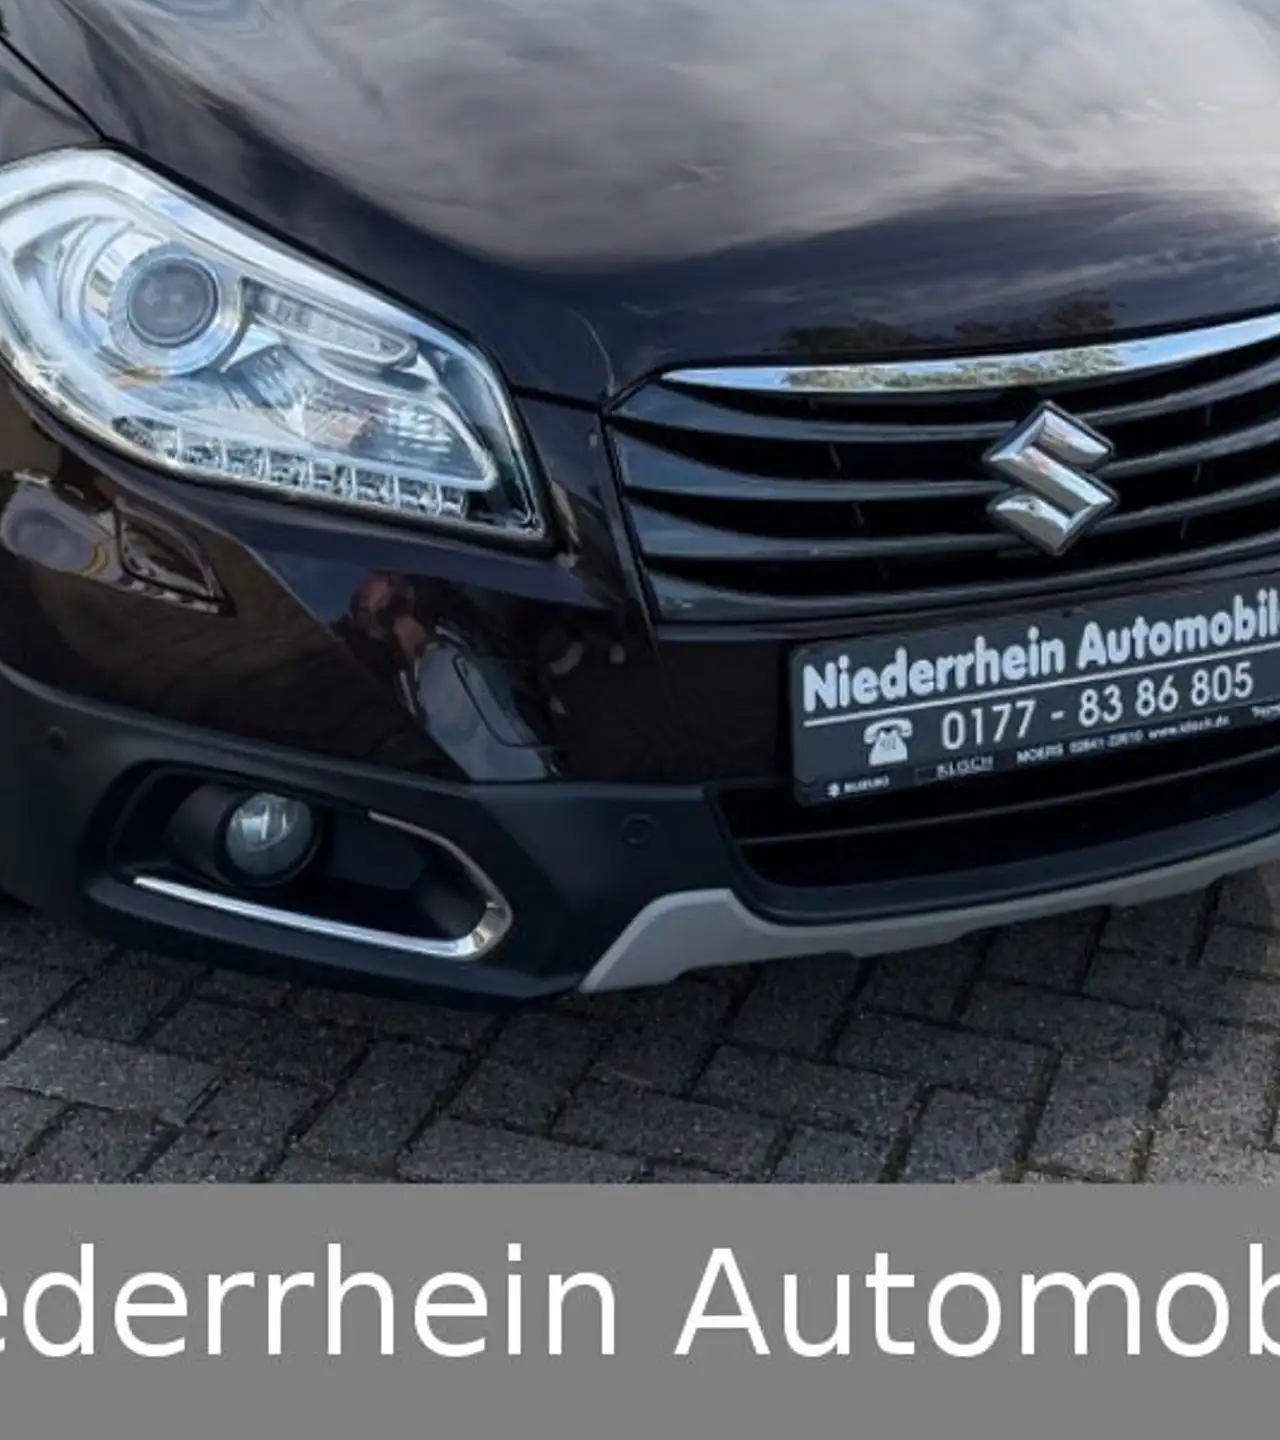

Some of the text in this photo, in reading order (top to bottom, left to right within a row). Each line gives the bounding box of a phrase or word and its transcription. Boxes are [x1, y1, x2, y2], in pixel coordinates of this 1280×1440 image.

[802, 626, 1066, 713] Niederrhein
[940, 698, 1037, 752] 0177
[1077, 685, 1123, 727] 83
[1135, 675, 1180, 717] 86
[1190, 661, 1254, 707] 805
